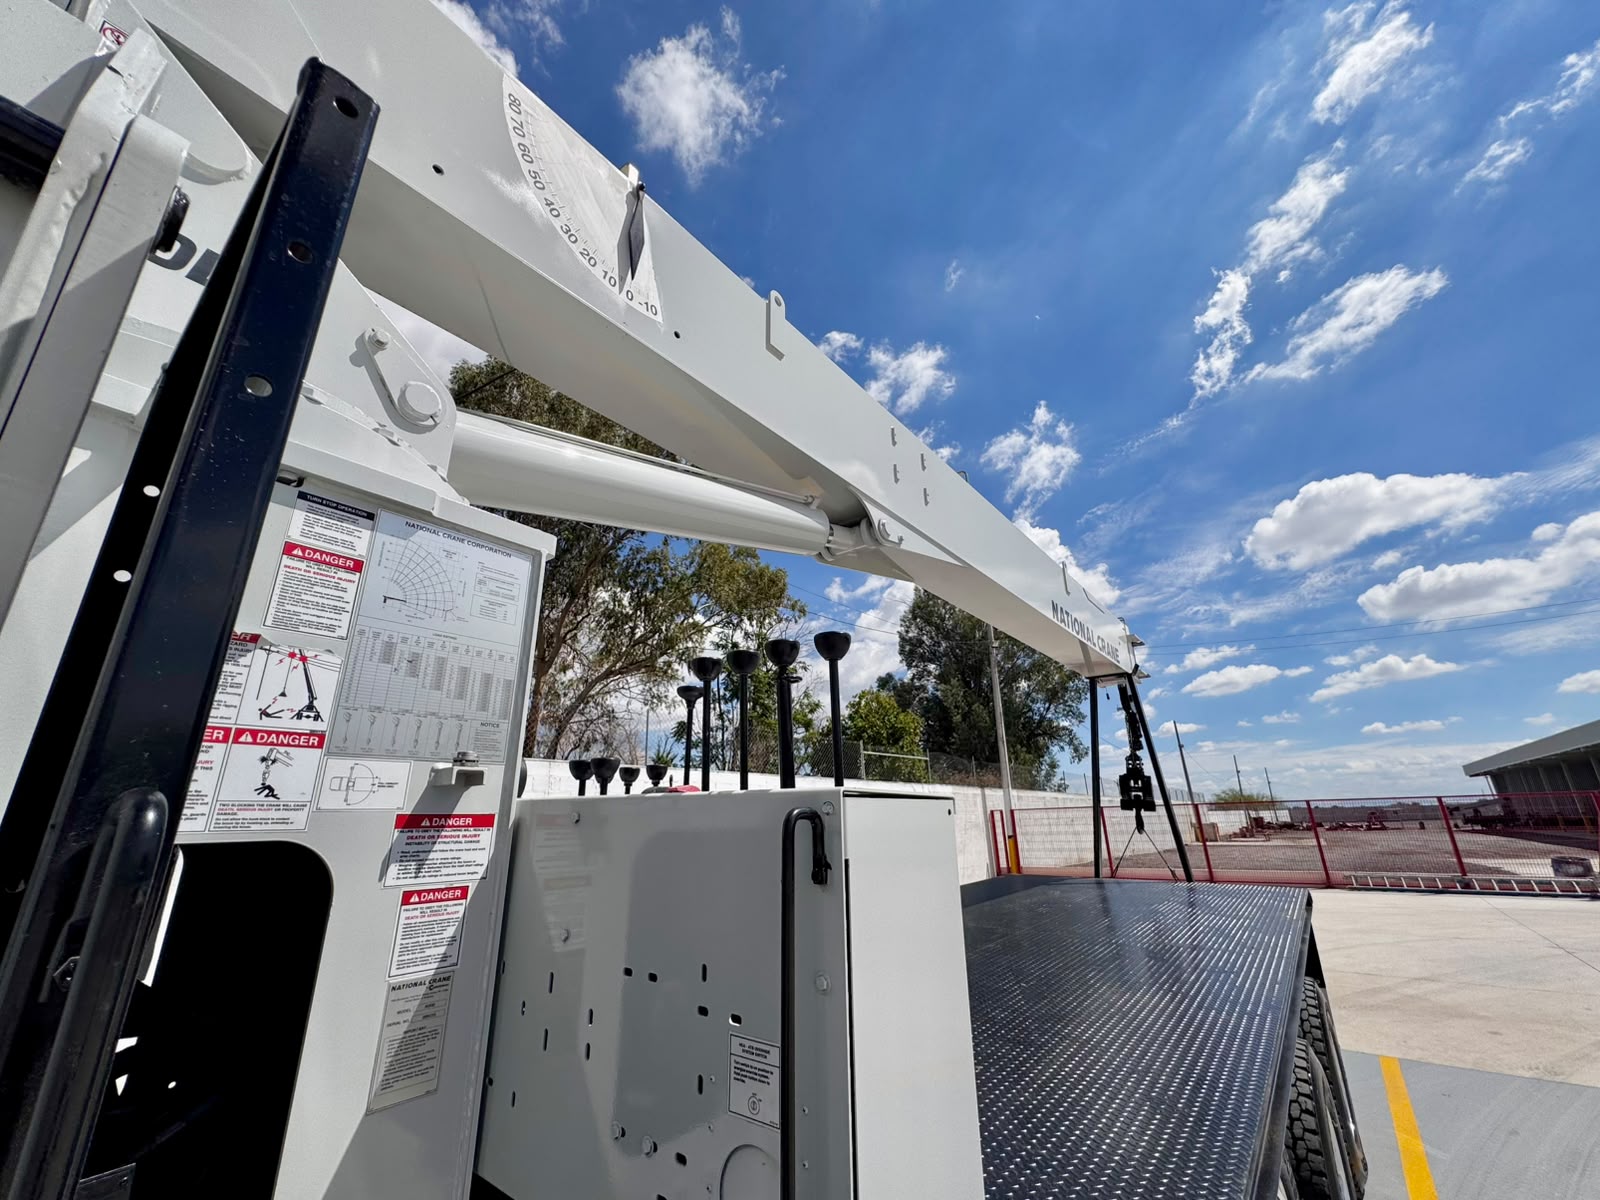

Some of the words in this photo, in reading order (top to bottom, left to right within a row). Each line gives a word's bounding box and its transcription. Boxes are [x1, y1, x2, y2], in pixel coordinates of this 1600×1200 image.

[508, 93, 522, 115] 80
[511, 115, 525, 138] 70
[518, 142, 534, 164] 60
[528, 169, 545, 191] 50
[543, 197, 560, 219] 40
[560, 224, 578, 245] 30
[579, 247, 597, 268] 20
[602, 270, 618, 288] 10
[626, 289, 634, 301] 0
[638, 300, 658, 316] -10
[306, 495, 322, 503] TURN
[322, 500, 337, 508] STOP
[337, 504, 368, 517] OPERATION
[405, 520, 441, 538] NATIONAL
[441, 532, 465, 548] CRANE
[465, 537, 512, 559] CORPORATION
[304, 549, 354, 568] DANGER
[1051, 599, 1096, 648] NATIONAL
[1097, 635, 1120, 664] CRANE
[256, 733, 319, 746] DANGER
[432, 817, 473, 826] DANGER
[420, 889, 462, 901] DANGER
[391, 979, 427, 992] NATIONAL
[428, 975, 451, 986] CRANE
